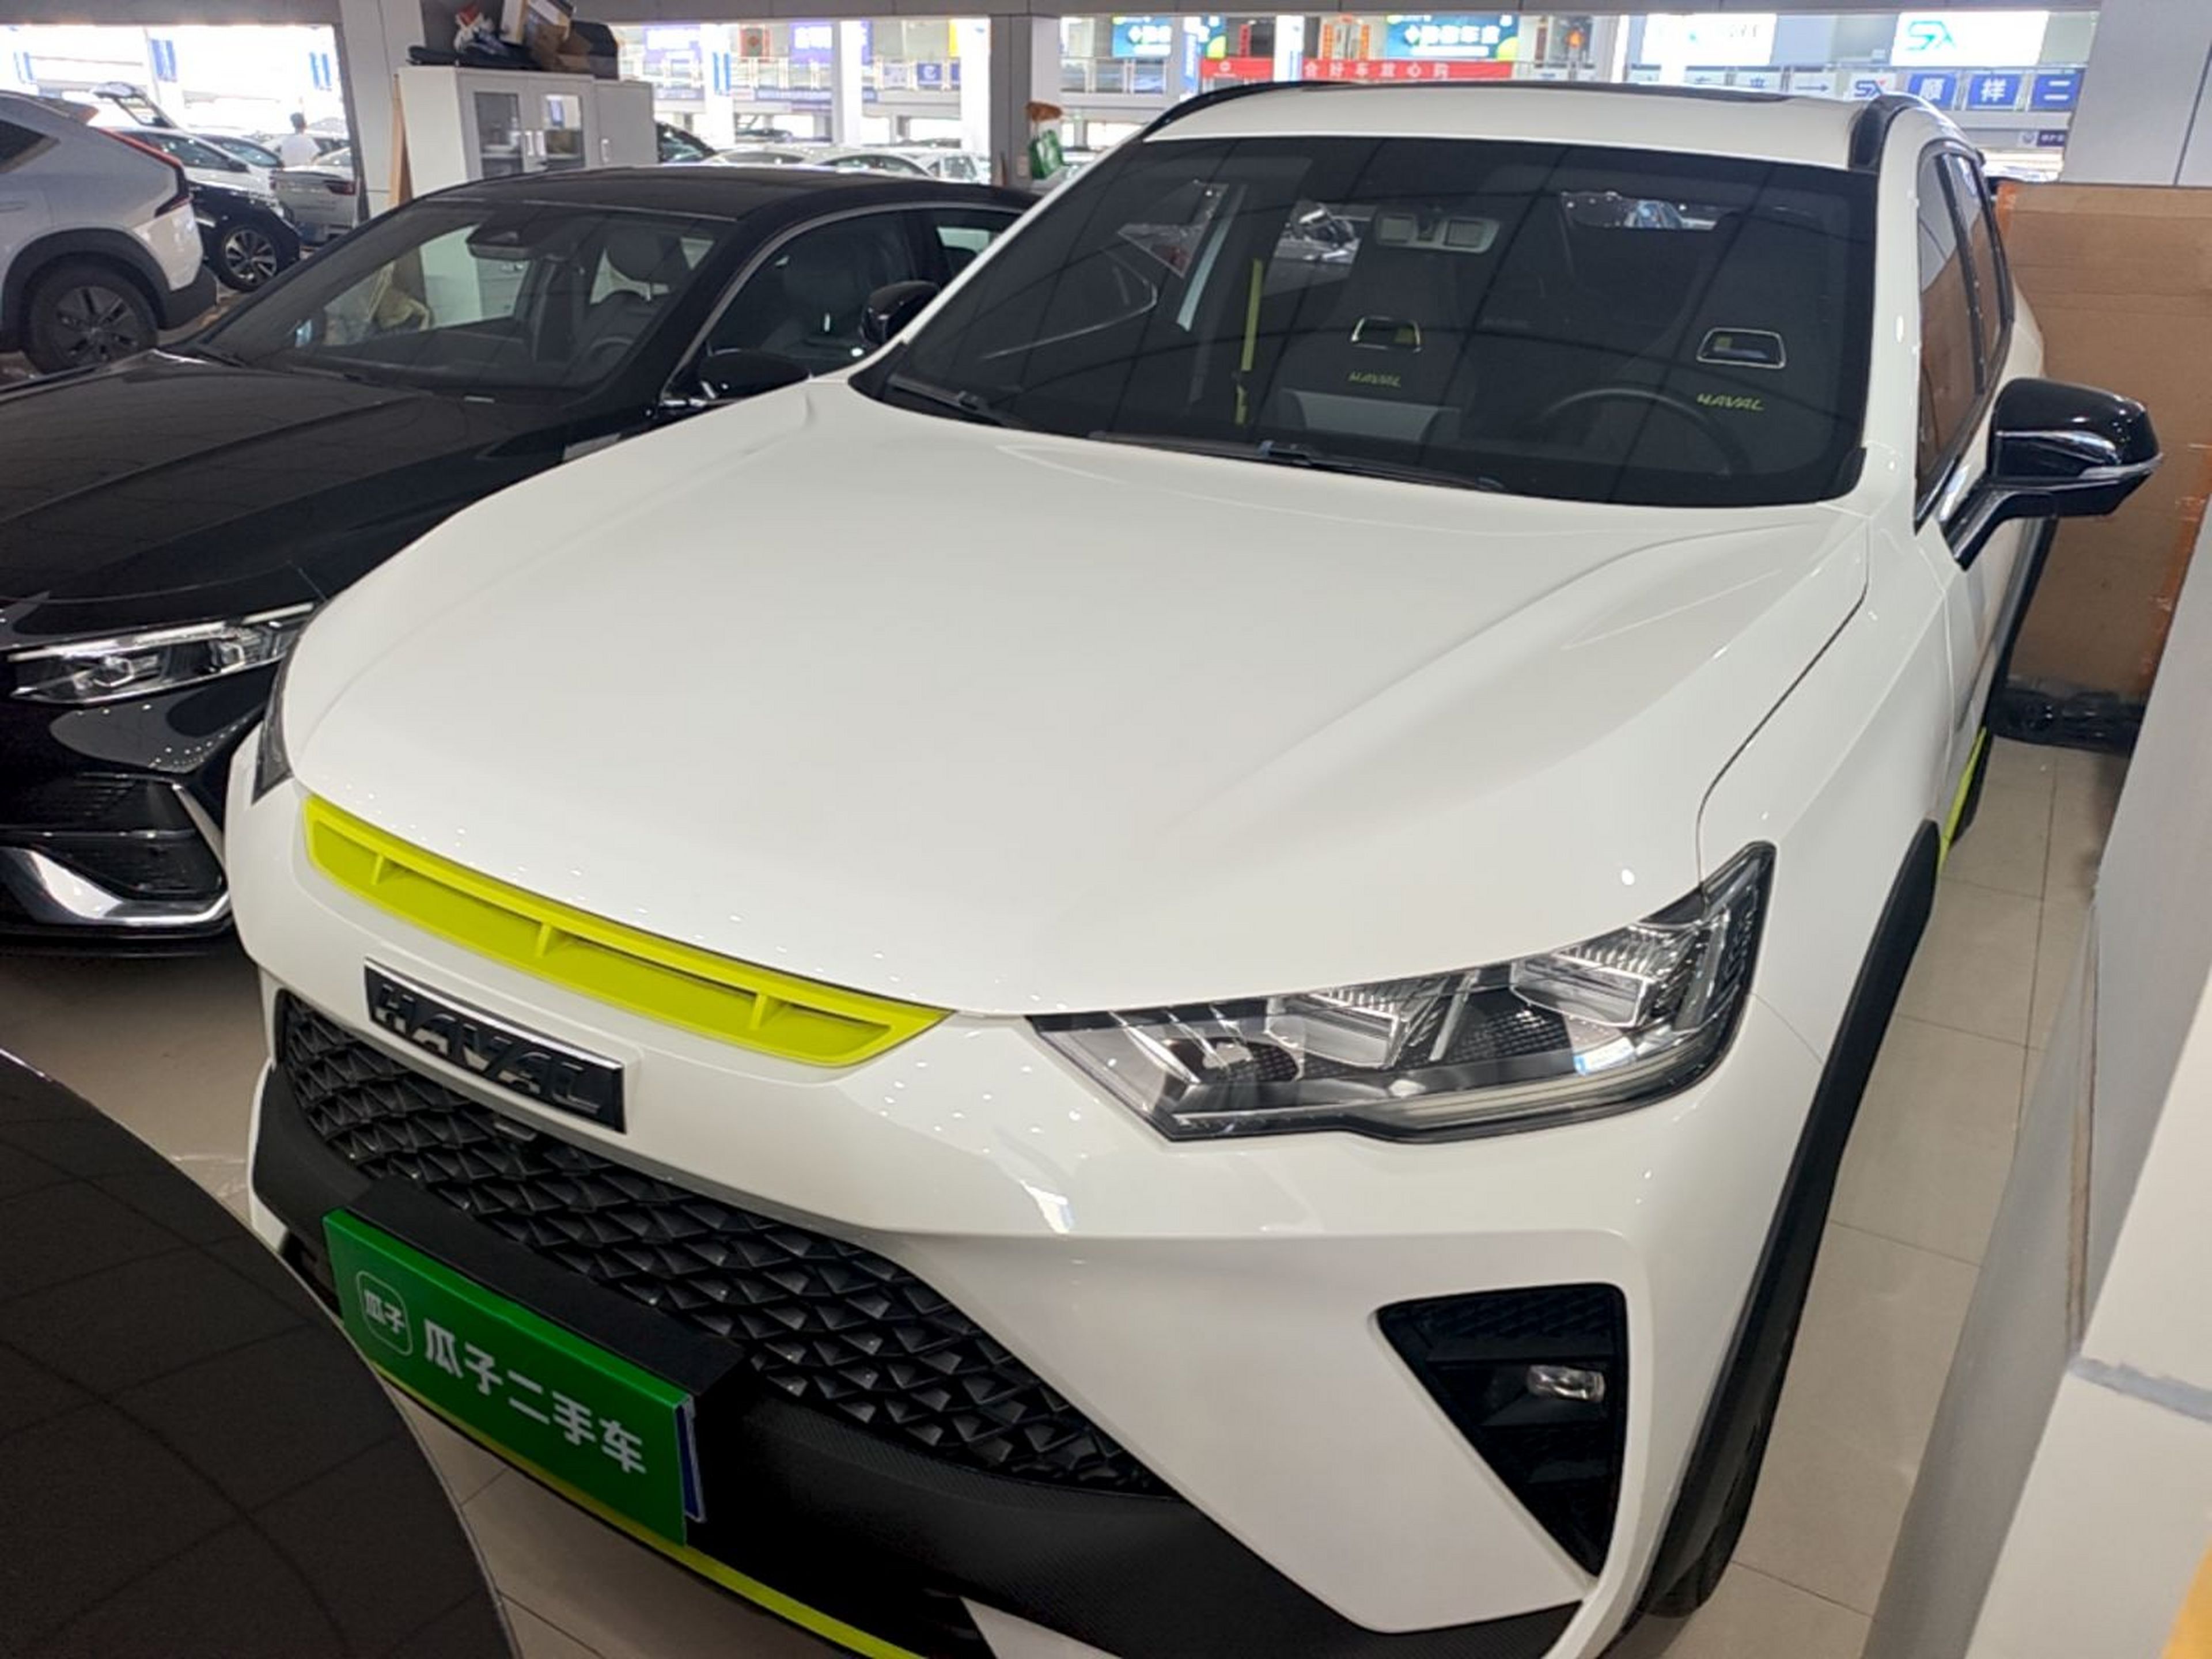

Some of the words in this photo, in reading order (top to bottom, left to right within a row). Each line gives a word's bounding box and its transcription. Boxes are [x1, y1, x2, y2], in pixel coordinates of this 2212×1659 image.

[1697, 393, 1764, 411] HAVAL
[374, 983, 601, 1115] HAVAL
[363, 1289, 406, 1334] 瓜子
[424, 1319, 647, 1475] 瓜子二手车
